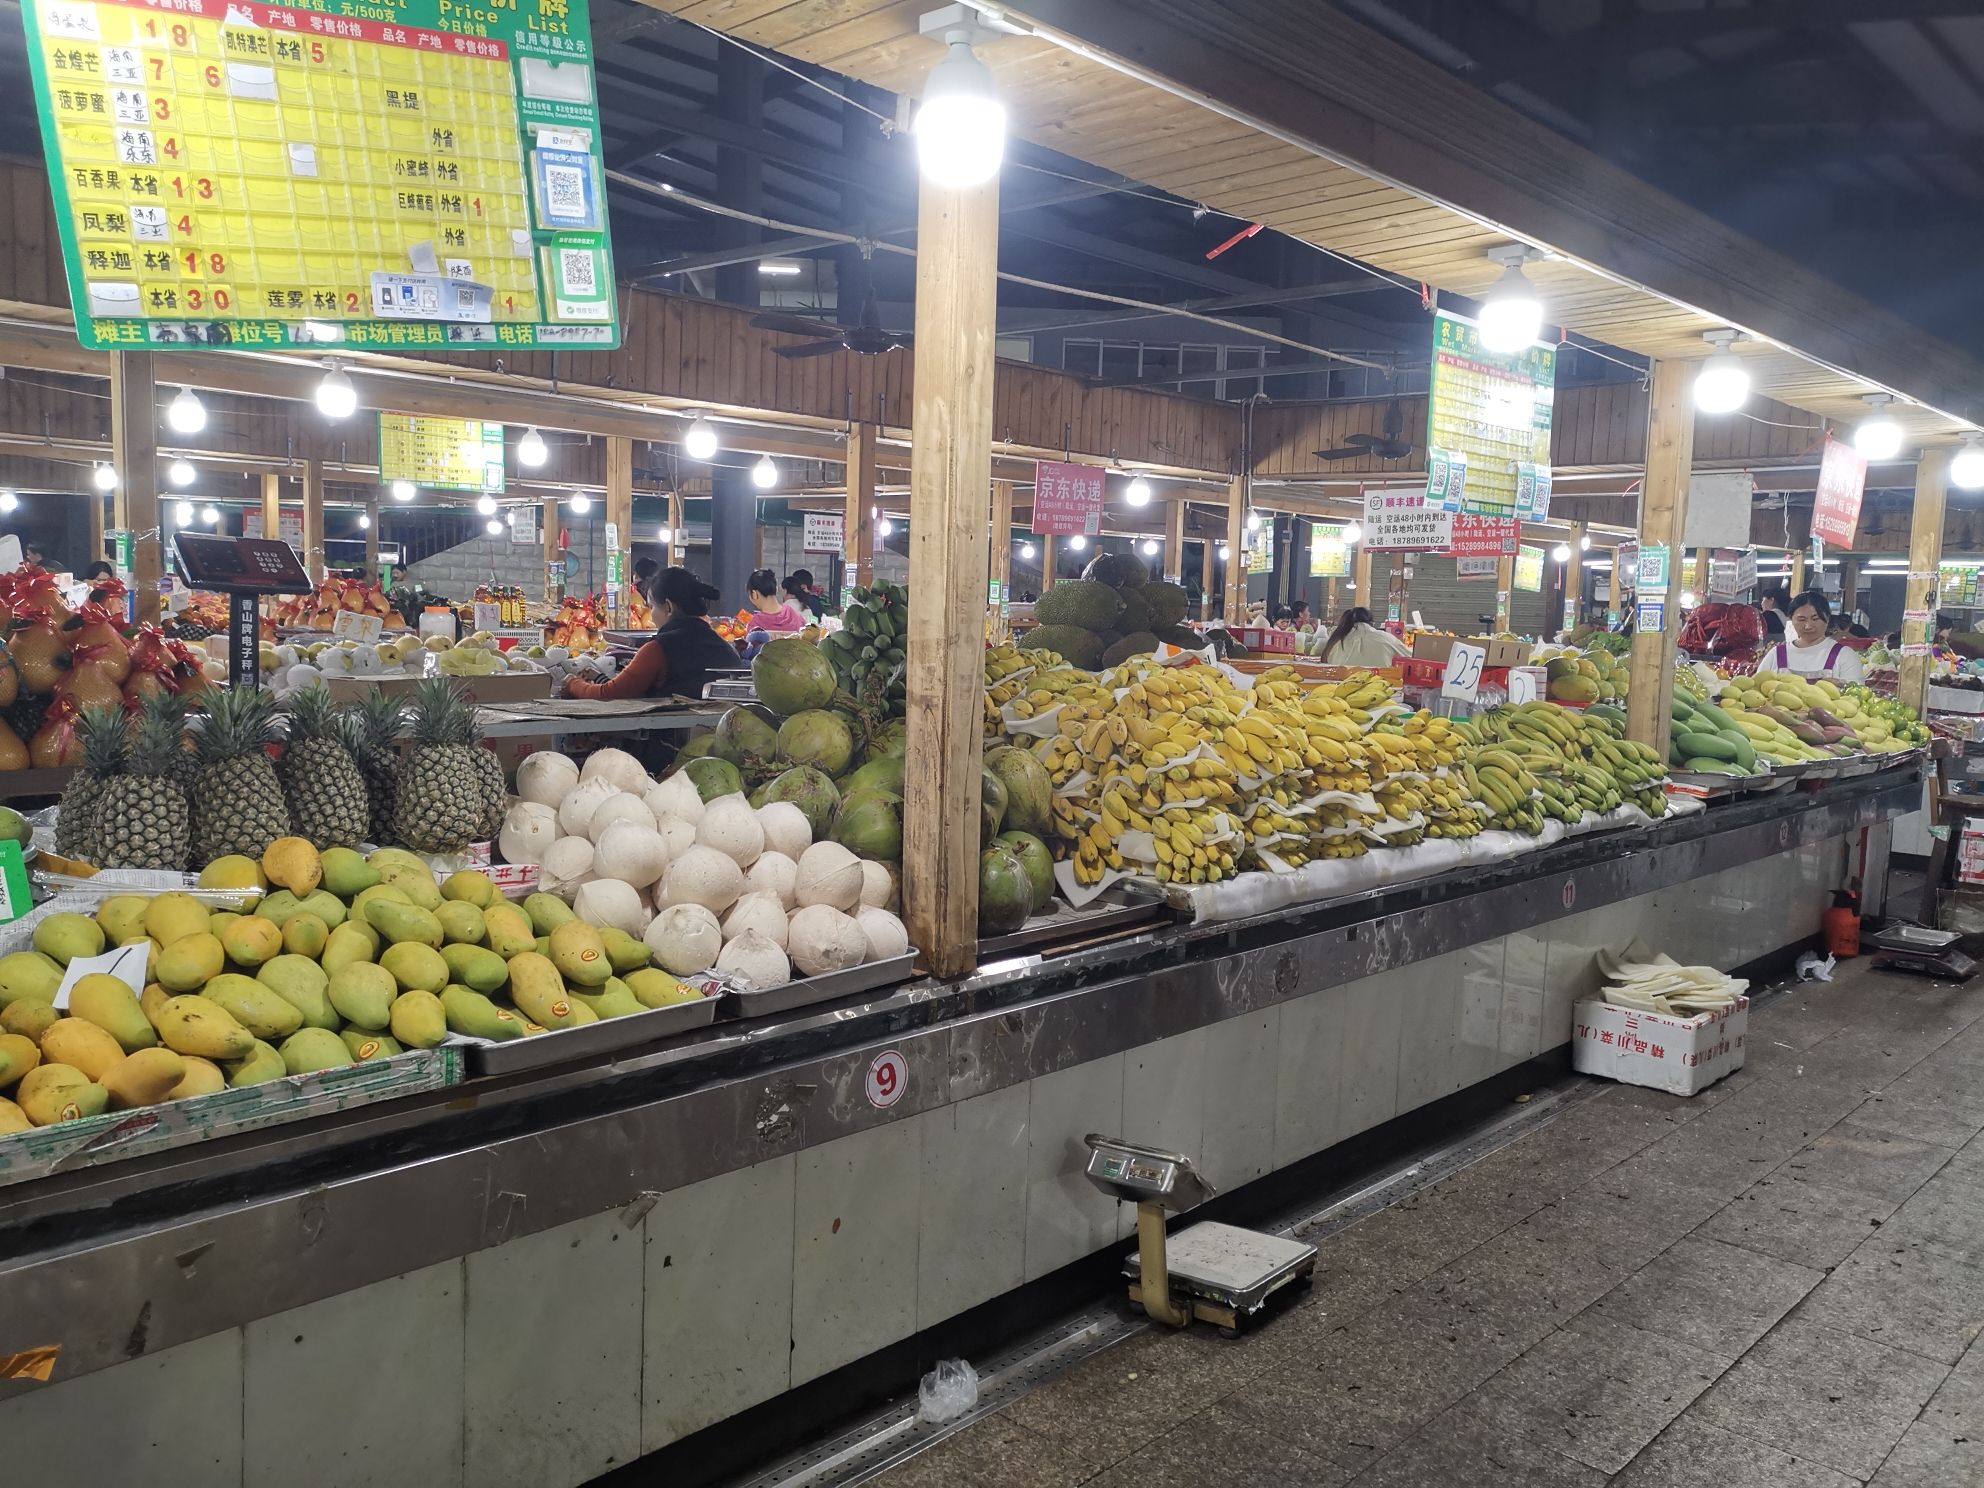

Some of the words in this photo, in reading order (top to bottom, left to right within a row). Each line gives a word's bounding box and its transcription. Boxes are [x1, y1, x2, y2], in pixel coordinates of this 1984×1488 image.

[437, 17, 488, 38] 今日价格
[439, 1, 499, 23] Price
[528, 14, 569, 35] List
[268, 10, 296, 28] 产地
[310, 15, 362, 37] 零售价格
[383, 28, 406, 44] 品名
[418, 33, 442, 49] 产地
[454, 39, 500, 57] 零售价格
[515, 30, 587, 52] 信用等级公示
[276, 39, 301, 61] 本省
[311, 42, 325, 63] 5
[53, 48, 100, 73] 金煌芒
[149, 58, 164, 81] 7
[204, 65, 221, 88] 6
[57, 89, 106, 114] 菠萝蜜
[154, 98, 170, 121] 3
[386, 89, 420, 111] 黑提
[163, 138, 179, 160] 4
[433, 127, 453, 149] 外省
[395, 158, 429, 178] 小蜜蜂
[437, 161, 458, 181] 外省
[73, 168, 121, 190] 百香果
[130, 173, 158, 196] 本省
[441, 194, 462, 214] 外省
[83, 212, 126, 233] 凤梨
[177, 215, 192, 237] 4
[445, 227, 465, 247] 外省
[87, 250, 132, 271] 释迦
[143, 250, 171, 273] 本省
[150, 288, 178, 310] 本省
[267, 290, 304, 309] 莲雾
[313, 290, 336, 311] 本省
[93, 320, 145, 344] 摊主
[349, 322, 444, 344] 市场管理员
[500, 325, 533, 344] 电话
[1039, 476, 1101, 502] 京东快递
[1377, 523, 1437, 535] 全国各地均可发货
[1563, 883, 1575, 898] 11
[876, 1062, 897, 1097] 9
